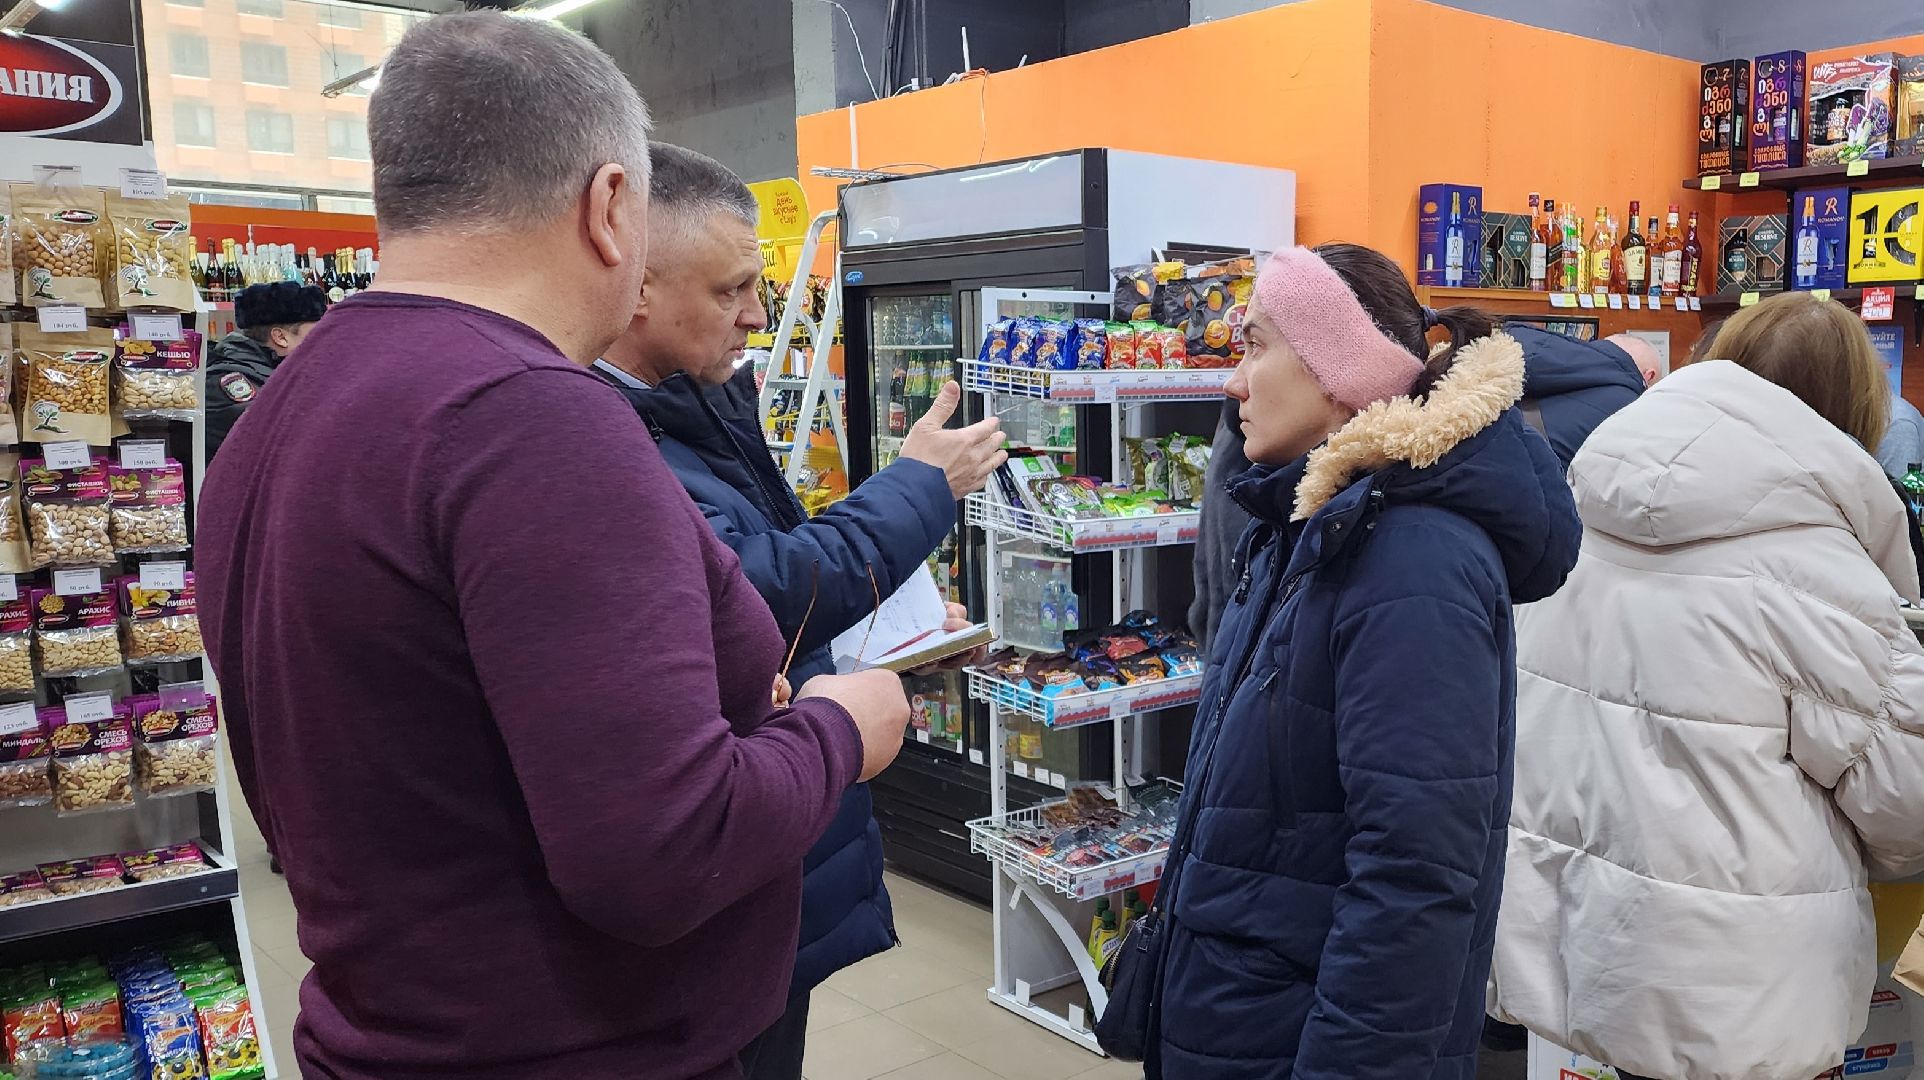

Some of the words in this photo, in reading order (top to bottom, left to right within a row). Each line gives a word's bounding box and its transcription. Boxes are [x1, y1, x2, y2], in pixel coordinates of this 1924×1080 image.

[1778, 60, 1786, 73] 8
[0, 67, 93, 103] АНИЯ
[1824, 197, 1838, 216] R
[156, 351, 191, 359] КЕШЬЮ
[166, 597, 196, 608] ПИВНА
[0, 609, 28, 619] РАХИС
[78, 606, 112, 616] АРАХИС
[186, 715, 213, 724] СМЕСЬ
[181, 721, 214, 732] ОРЕХОВ
[98, 730, 128, 739] СМЕСЬ
[2, 738, 45, 749] МИНДАЛЬ
[93, 736, 128, 747] ОРЕХОВ
